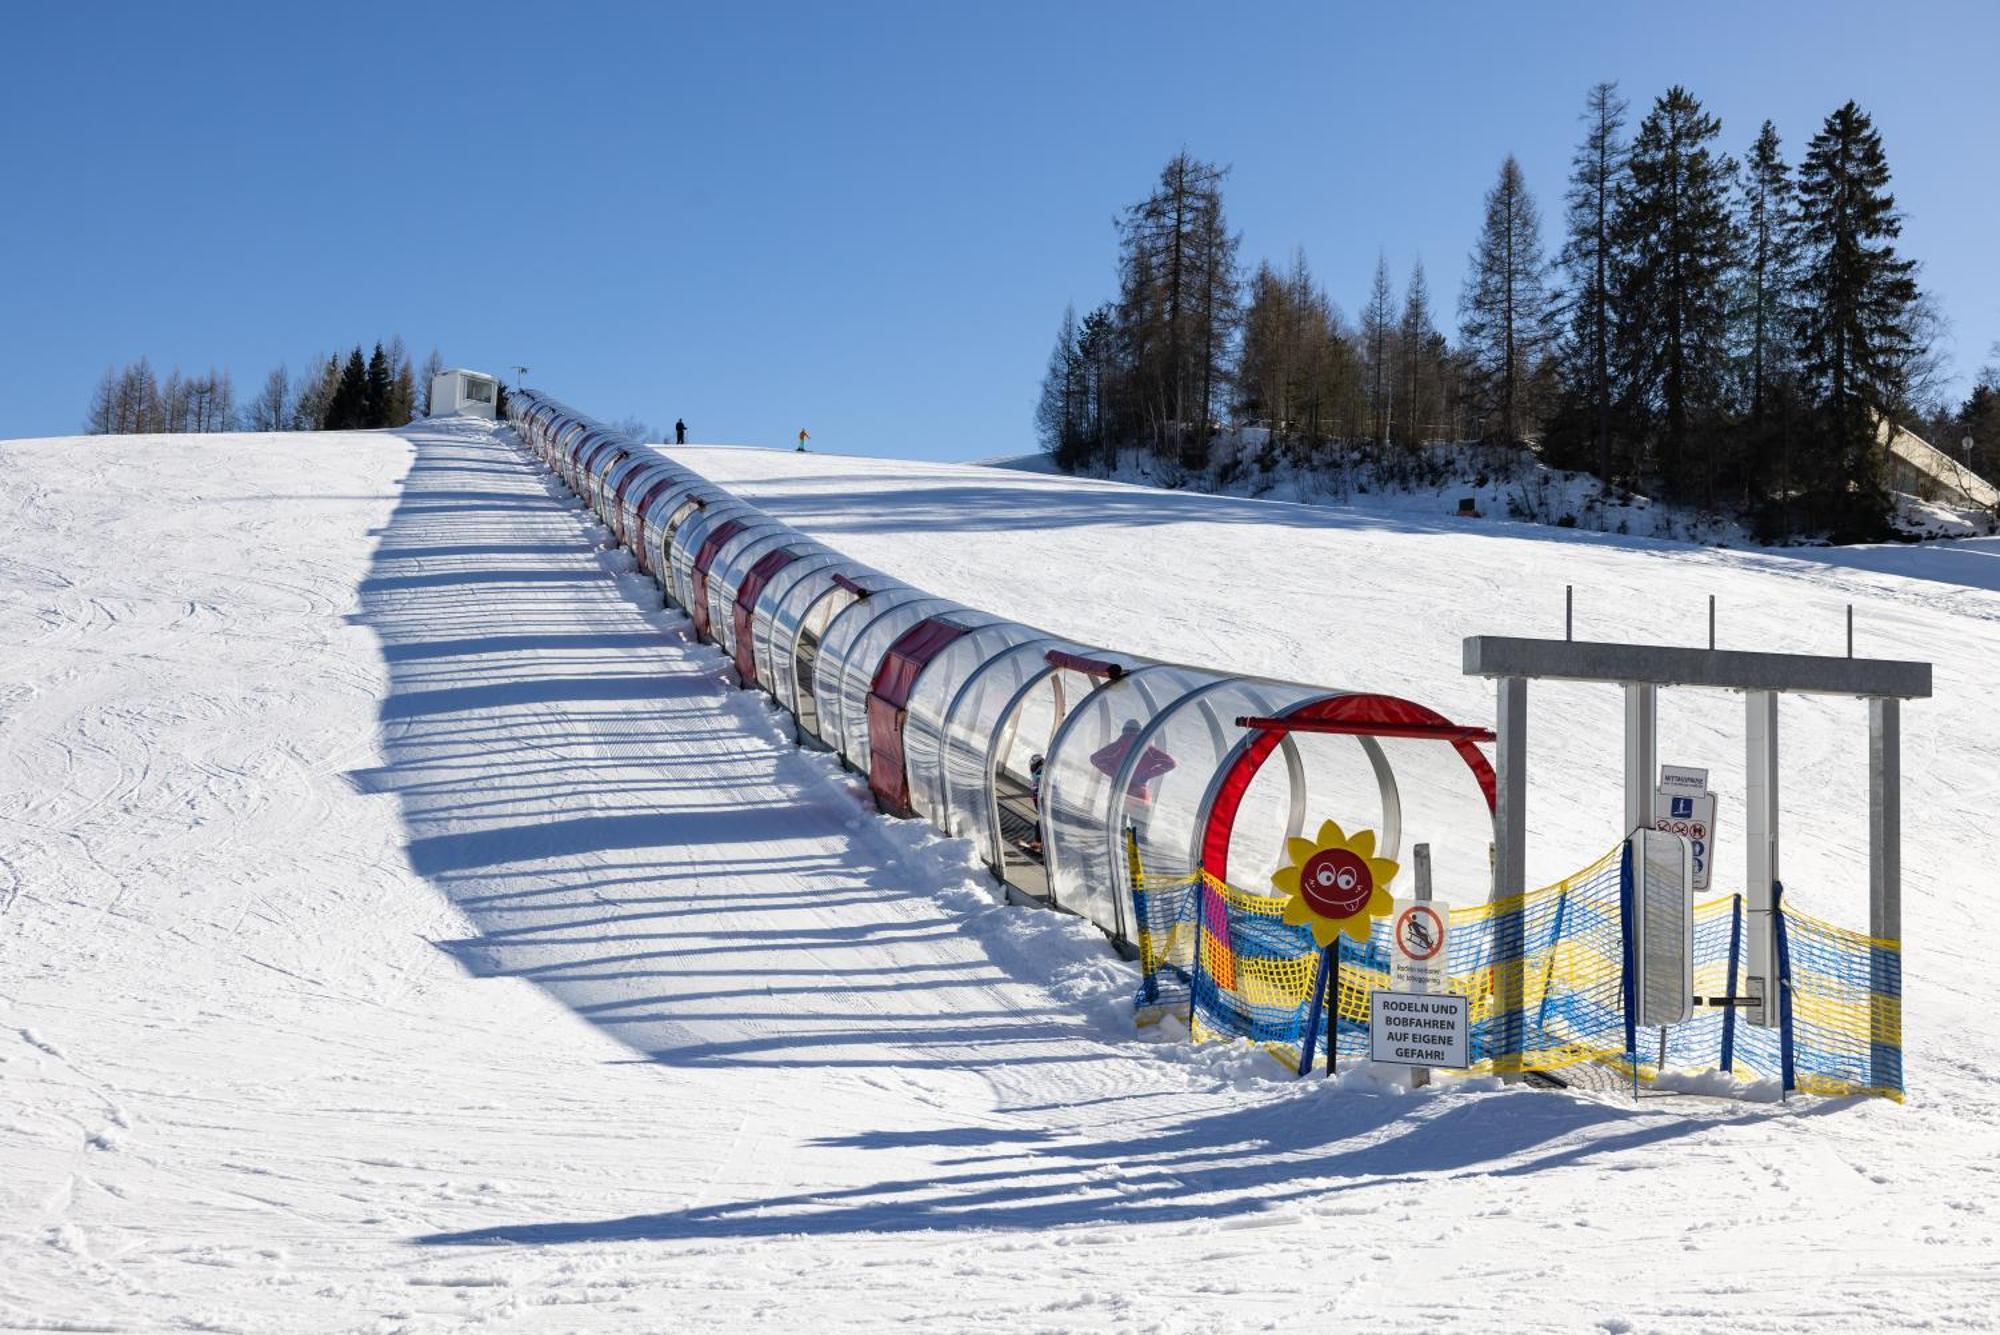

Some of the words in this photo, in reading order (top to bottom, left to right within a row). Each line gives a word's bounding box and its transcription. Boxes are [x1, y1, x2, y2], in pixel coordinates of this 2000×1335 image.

[1383, 1001, 1429, 1013] RODELN
[1432, 1003, 1458, 1015] UND
[1385, 1016, 1455, 1030] BOBFAHREN
[1387, 1031, 1409, 1042] AUF
[1412, 1033, 1454, 1046] EIGENE
[1395, 1047, 1445, 1061] GEFAHR!
